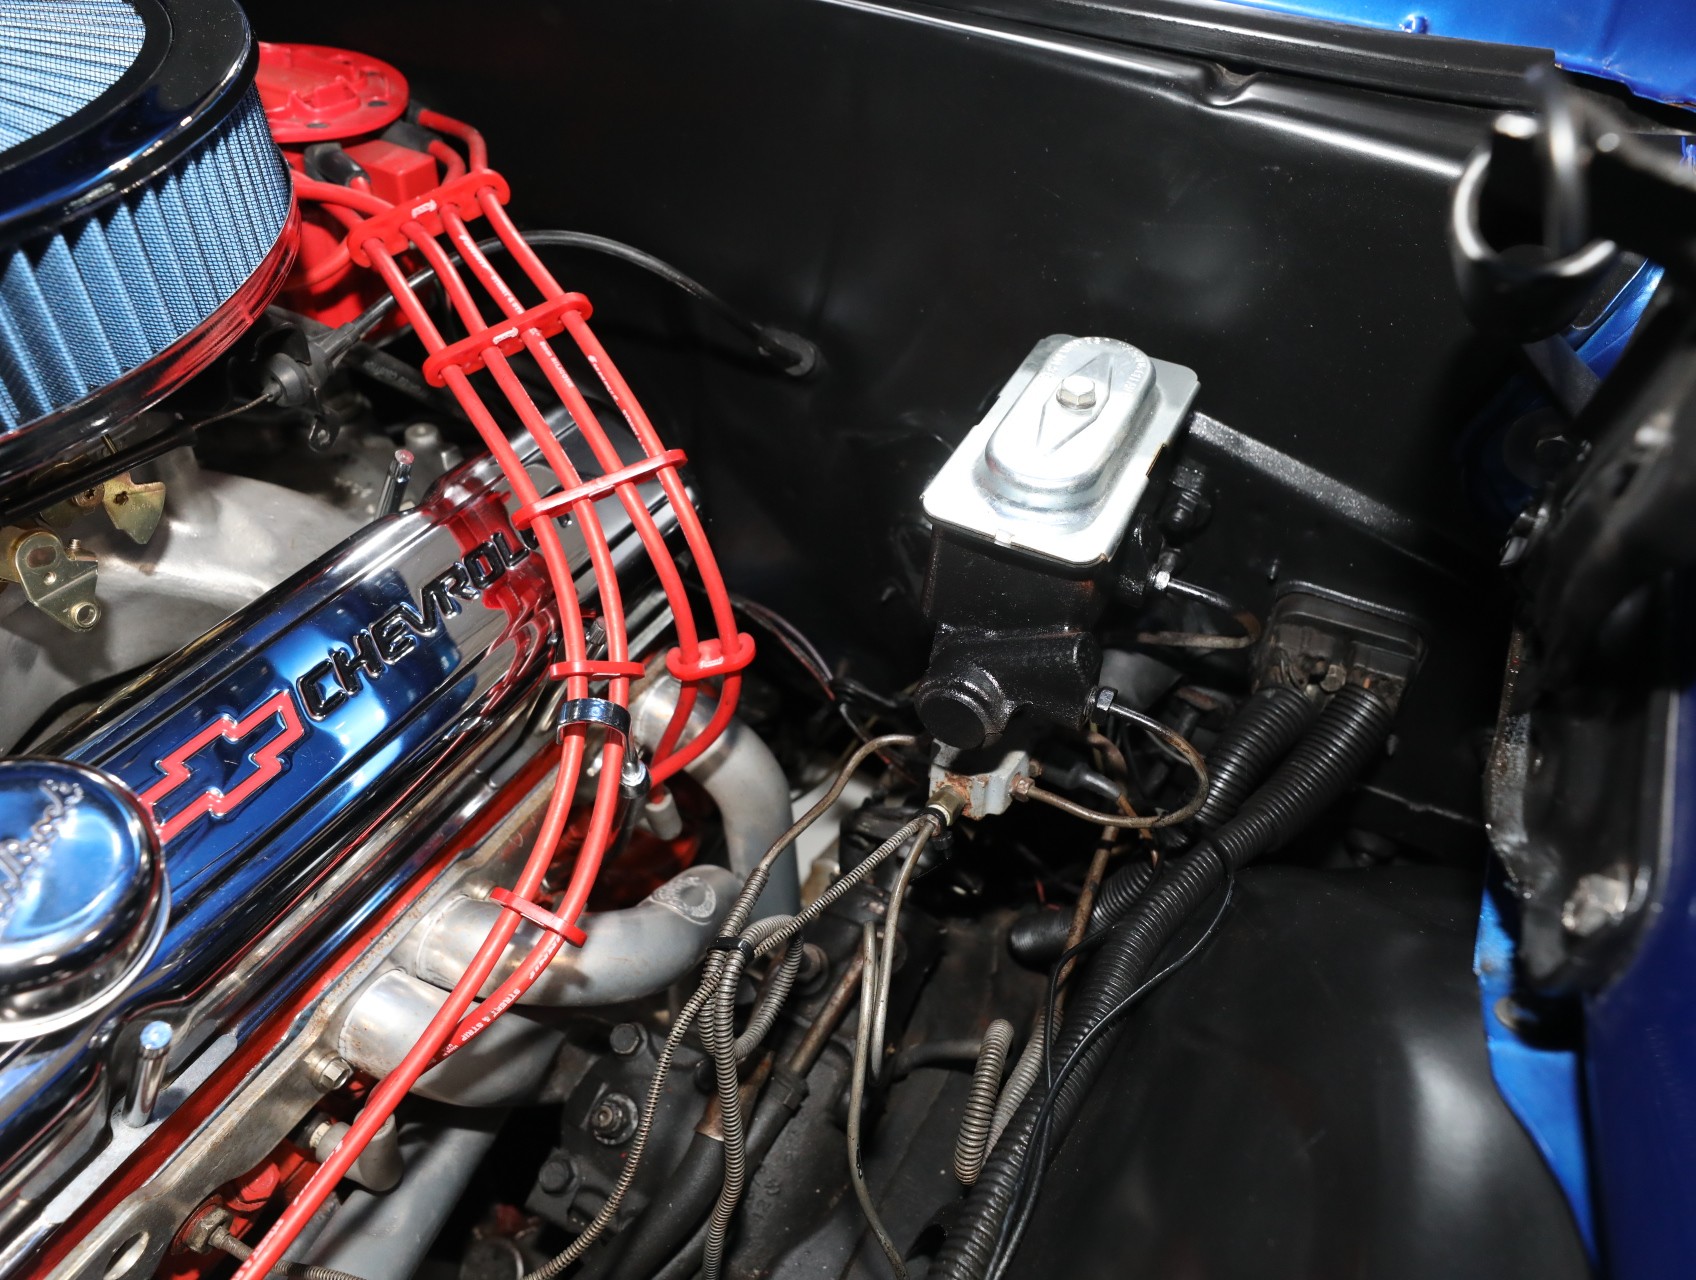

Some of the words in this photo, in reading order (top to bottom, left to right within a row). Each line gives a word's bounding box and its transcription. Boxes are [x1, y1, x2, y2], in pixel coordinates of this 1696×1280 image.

[551, 356, 575, 388] SILICONE
[296, 484, 573, 722] CHEVROL
[491, 988, 521, 1018] STREET
[461, 1022, 484, 1042] STRIP
